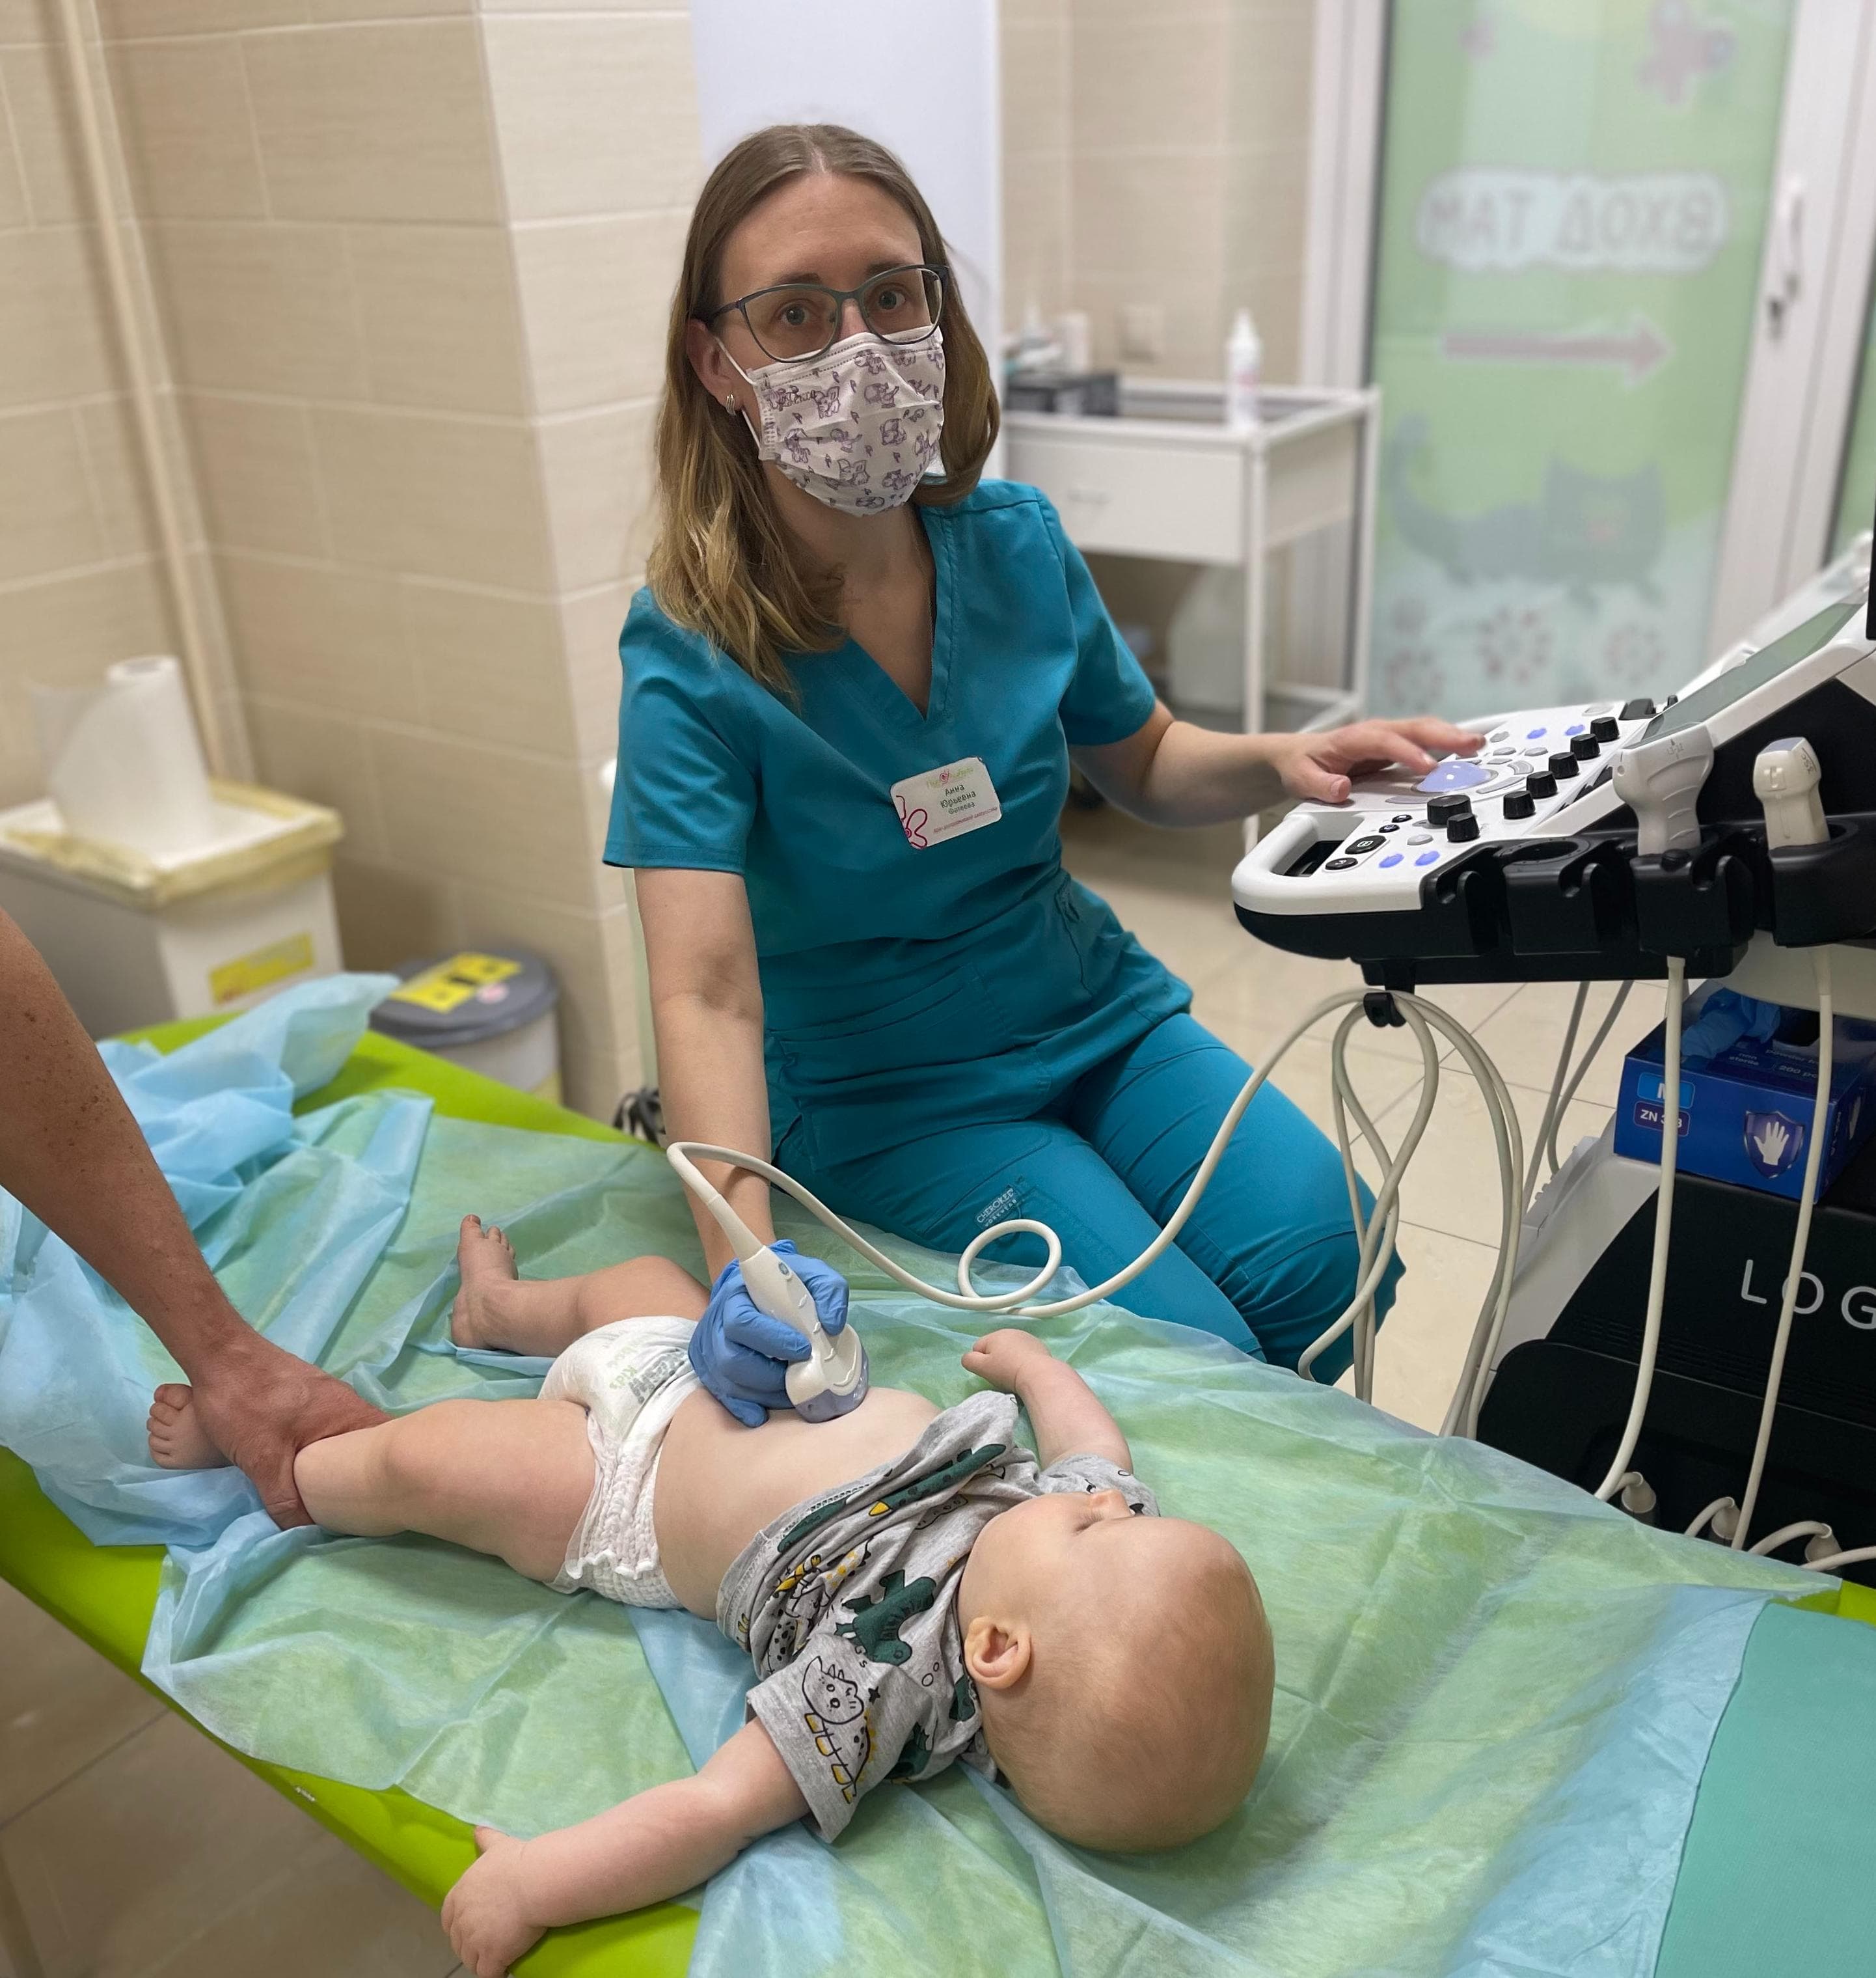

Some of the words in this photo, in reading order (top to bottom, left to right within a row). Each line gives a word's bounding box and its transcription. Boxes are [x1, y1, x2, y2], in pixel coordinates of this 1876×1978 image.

[945, 784, 964, 796] Анна
[1778, 1065, 1801, 1074] 200
[1640, 1109, 1658, 1122] ZN
[977, 1188, 1014, 1223] CHEROKEE
